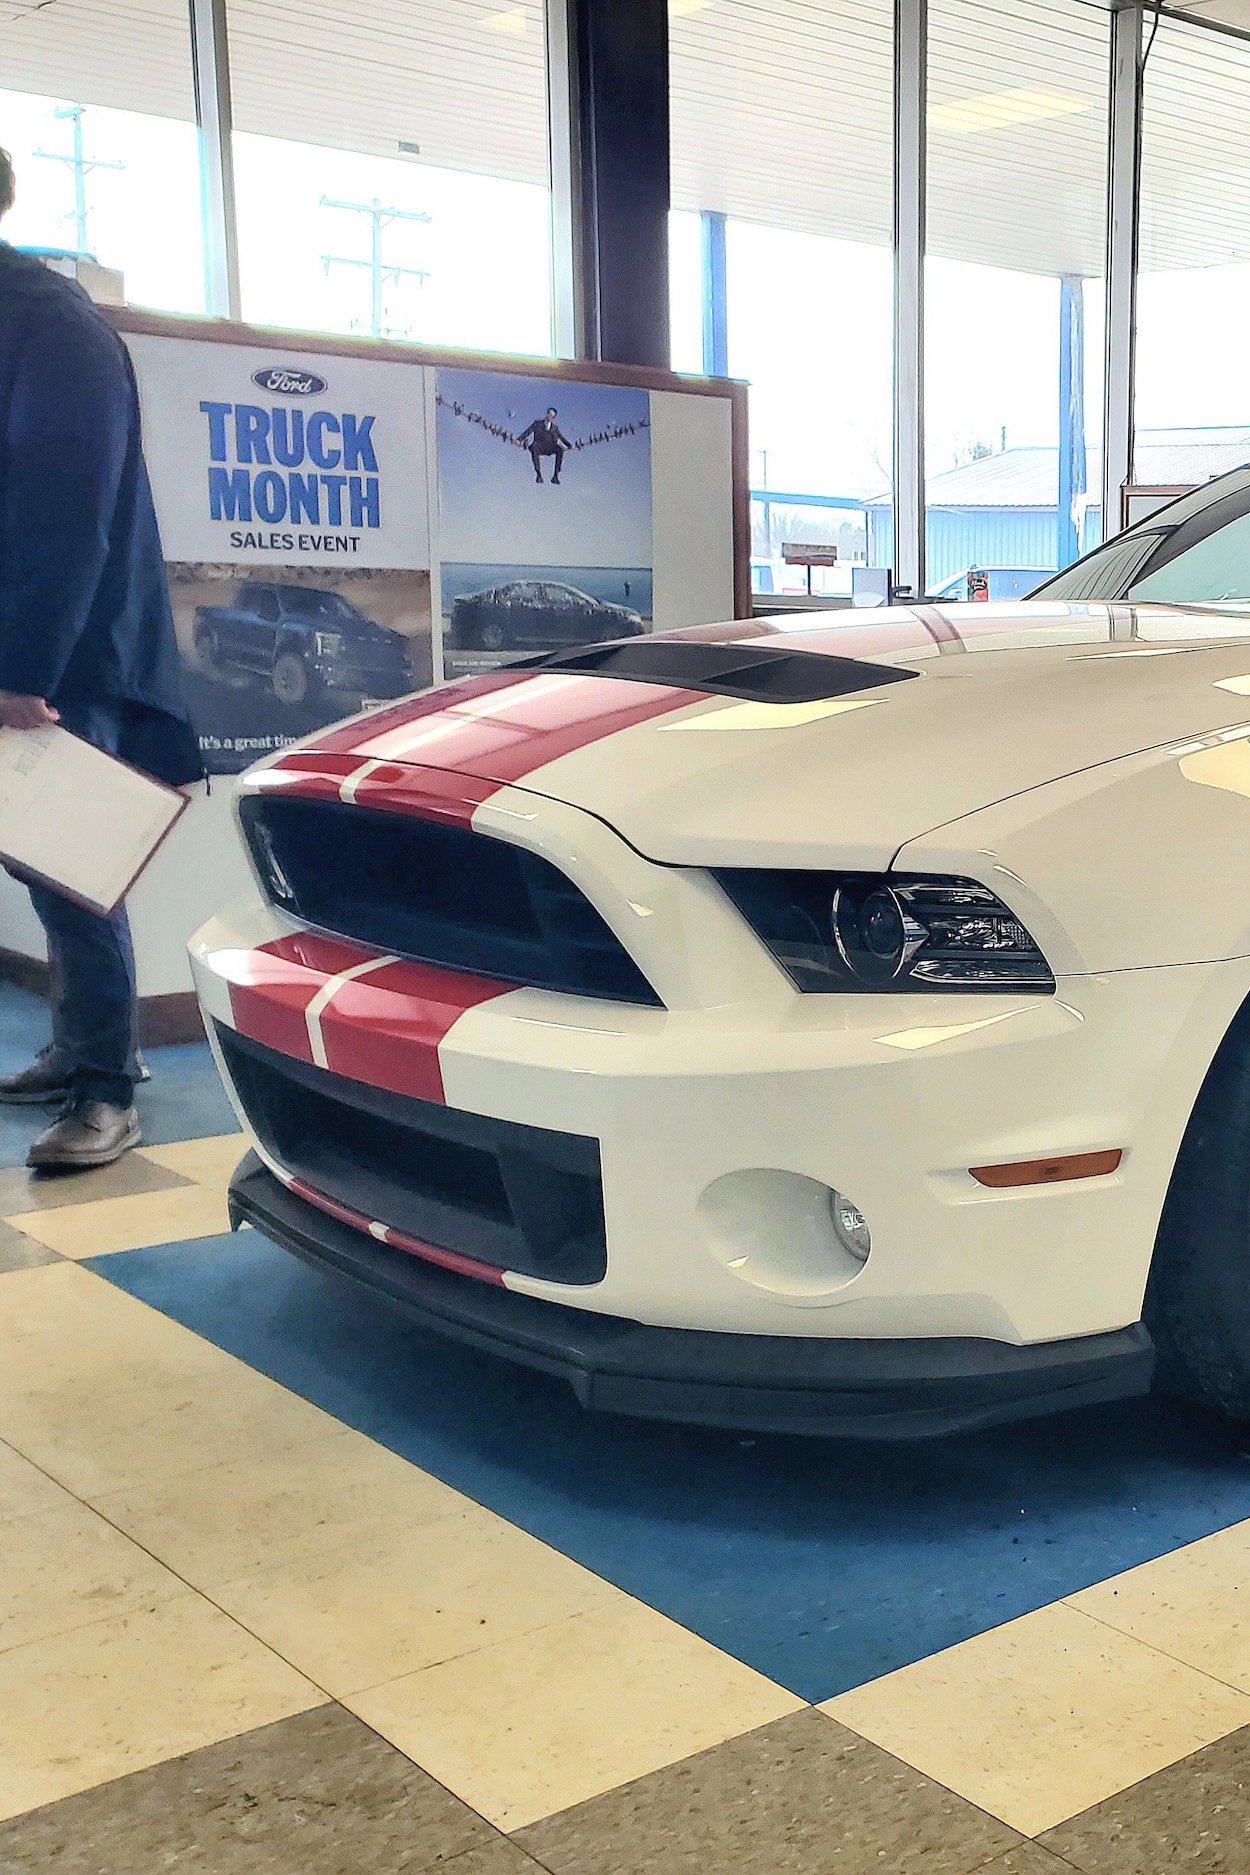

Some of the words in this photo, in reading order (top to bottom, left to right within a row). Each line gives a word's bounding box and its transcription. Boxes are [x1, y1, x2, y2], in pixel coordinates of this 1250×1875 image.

[266, 370, 314, 394] Ford
[200, 400, 379, 473] TRUCK
[208, 467, 381, 529] MONTH
[230, 530, 294, 550] SALES
[299, 534, 361, 552] EVENT
[198, 735, 220, 750] It's
[223, 738, 233, 749] a
[235, 736, 273, 752] great
